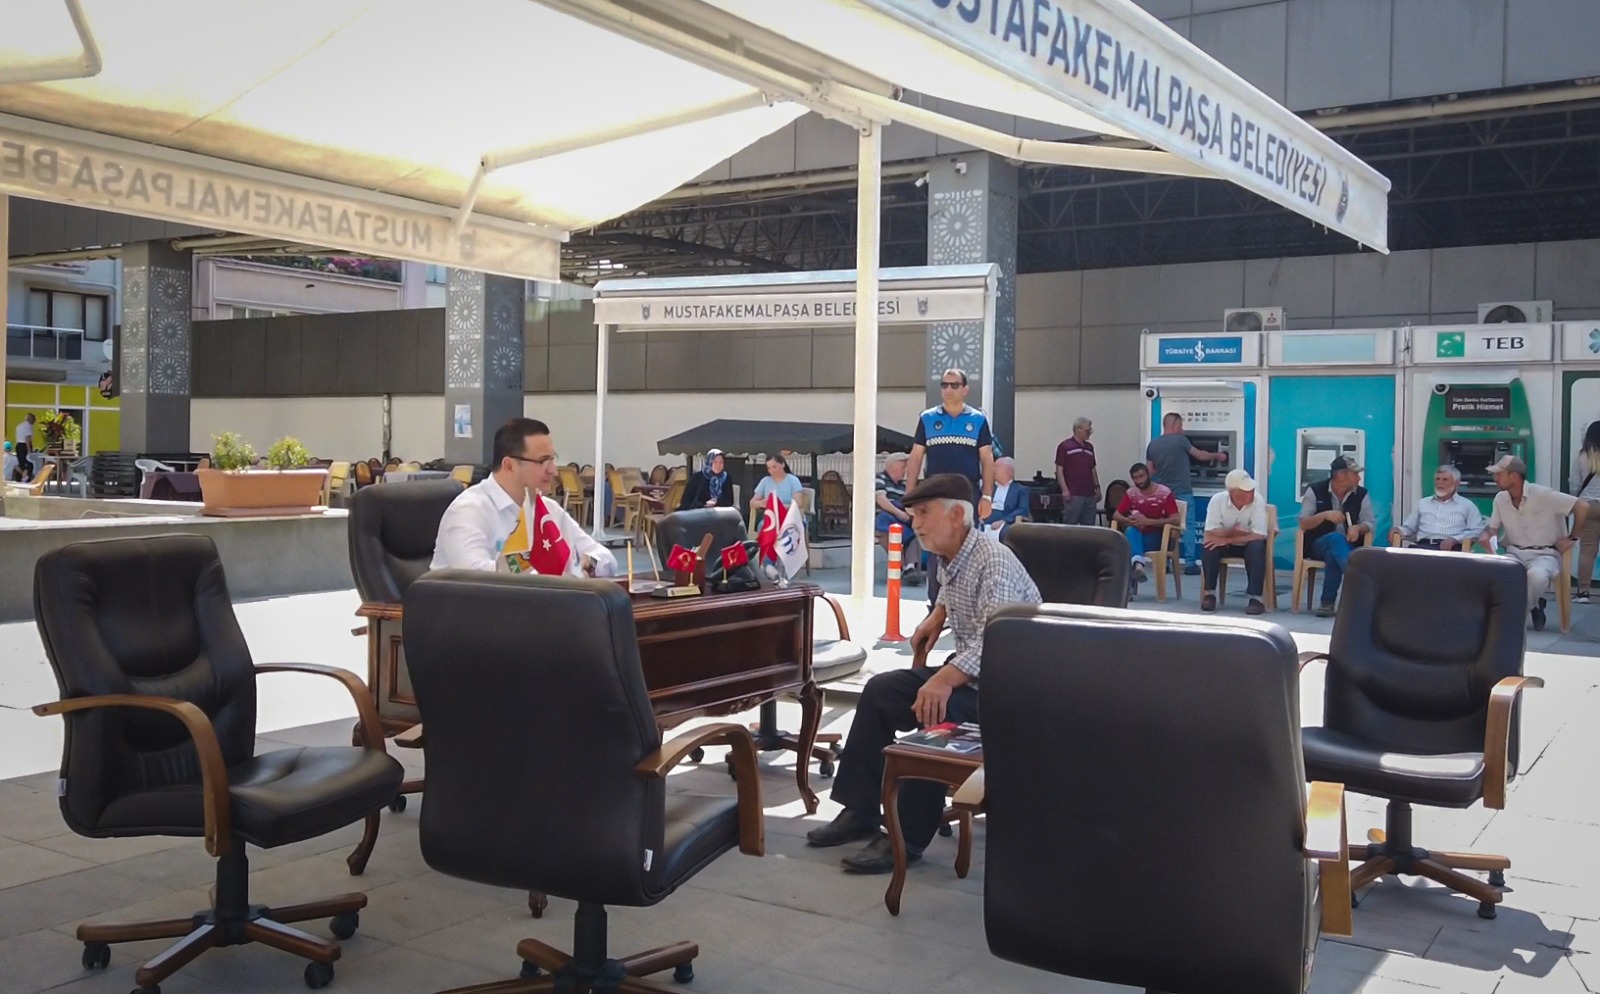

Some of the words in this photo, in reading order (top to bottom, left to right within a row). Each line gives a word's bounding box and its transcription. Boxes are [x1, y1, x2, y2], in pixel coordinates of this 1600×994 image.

[930, 0, 1226, 159] TAFAKEMALPAŞA
[1231, 114, 1327, 208] BELEDİYESİ
[663, 303, 810, 321] MUSTAFAKEMALPAŞA
[814, 297, 900, 317] BELEESİ
[1482, 336, 1525, 350] TEB
[1476, 403, 1504, 411] Hizmet
